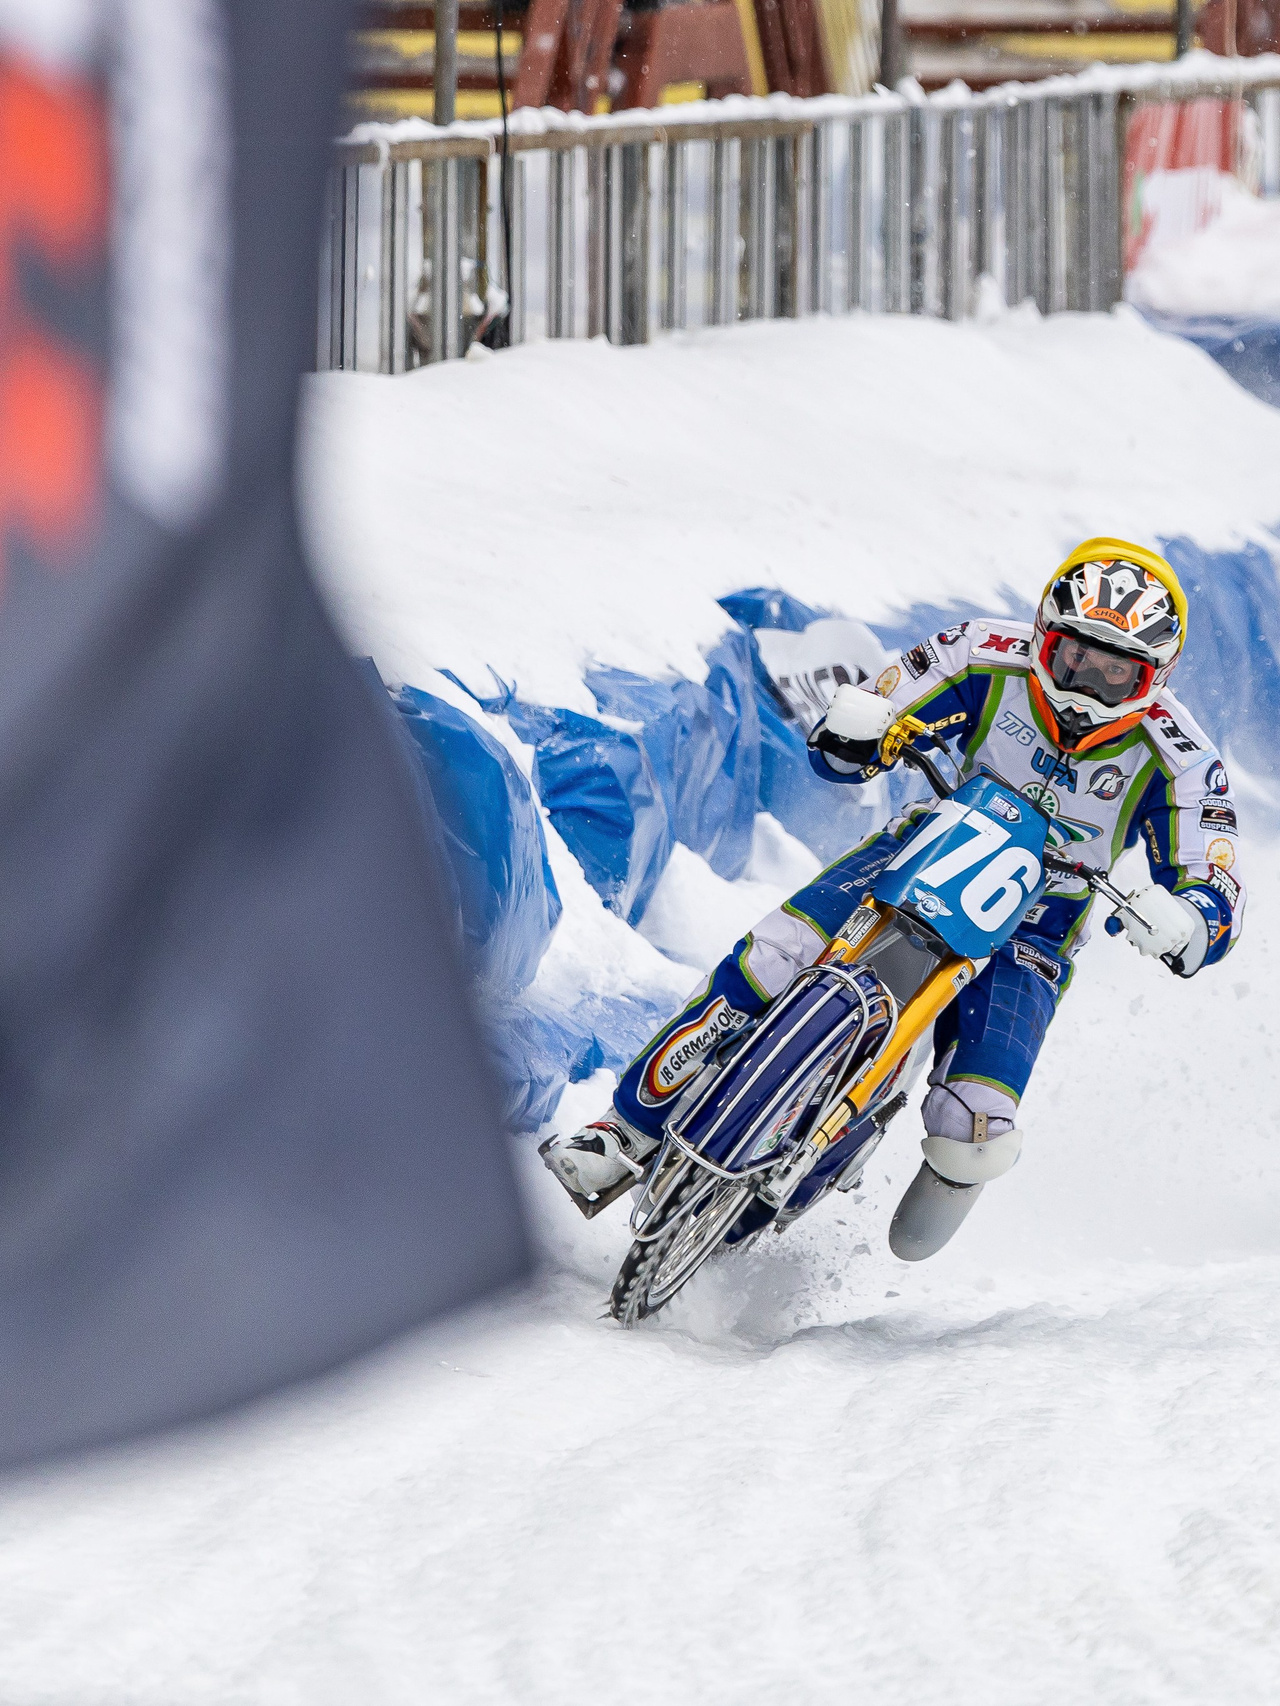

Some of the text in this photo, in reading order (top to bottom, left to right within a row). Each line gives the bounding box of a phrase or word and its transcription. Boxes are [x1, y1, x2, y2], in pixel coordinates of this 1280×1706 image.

[1095, 610, 1125, 626] SHOEI
[996, 711, 1038, 747] 776
[1031, 747, 1079, 794] UFA
[1213, 864, 1239, 898] COOL
[660, 1065, 674, 1085] JB
[669, 1022, 718, 1071] GERMAN
[717, 1004, 737, 1028] OIL
